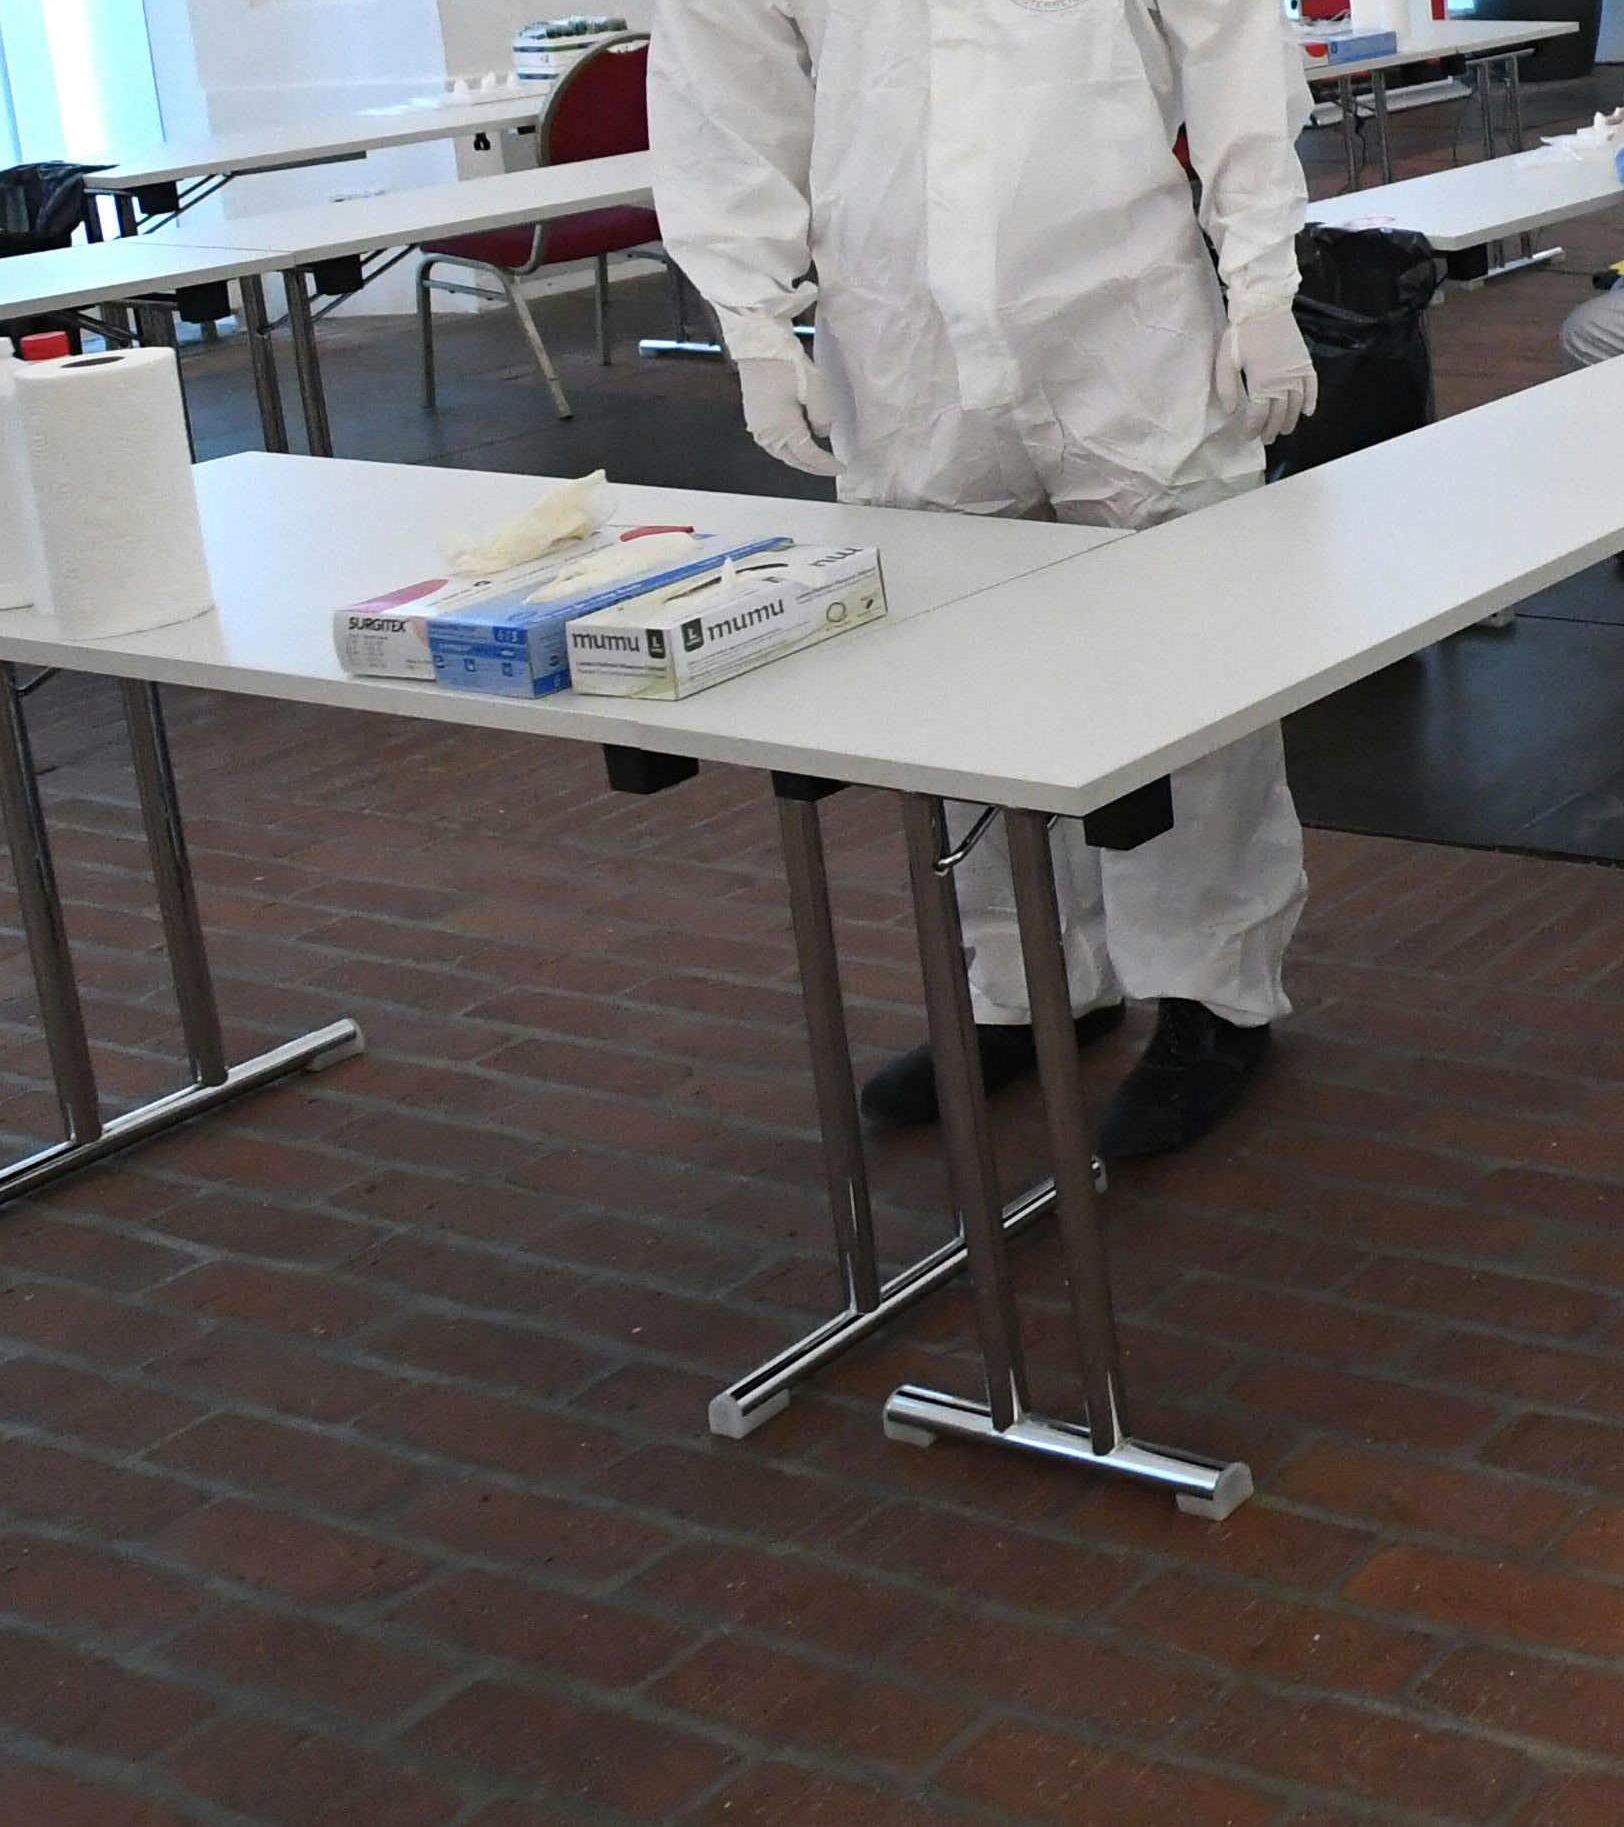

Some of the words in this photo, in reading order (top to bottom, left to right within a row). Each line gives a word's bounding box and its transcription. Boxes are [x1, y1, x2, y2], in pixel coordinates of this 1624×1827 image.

[347, 617, 407, 633] SURGITEX
[707, 598, 785, 642] mumu
[572, 631, 640, 653] mumu
